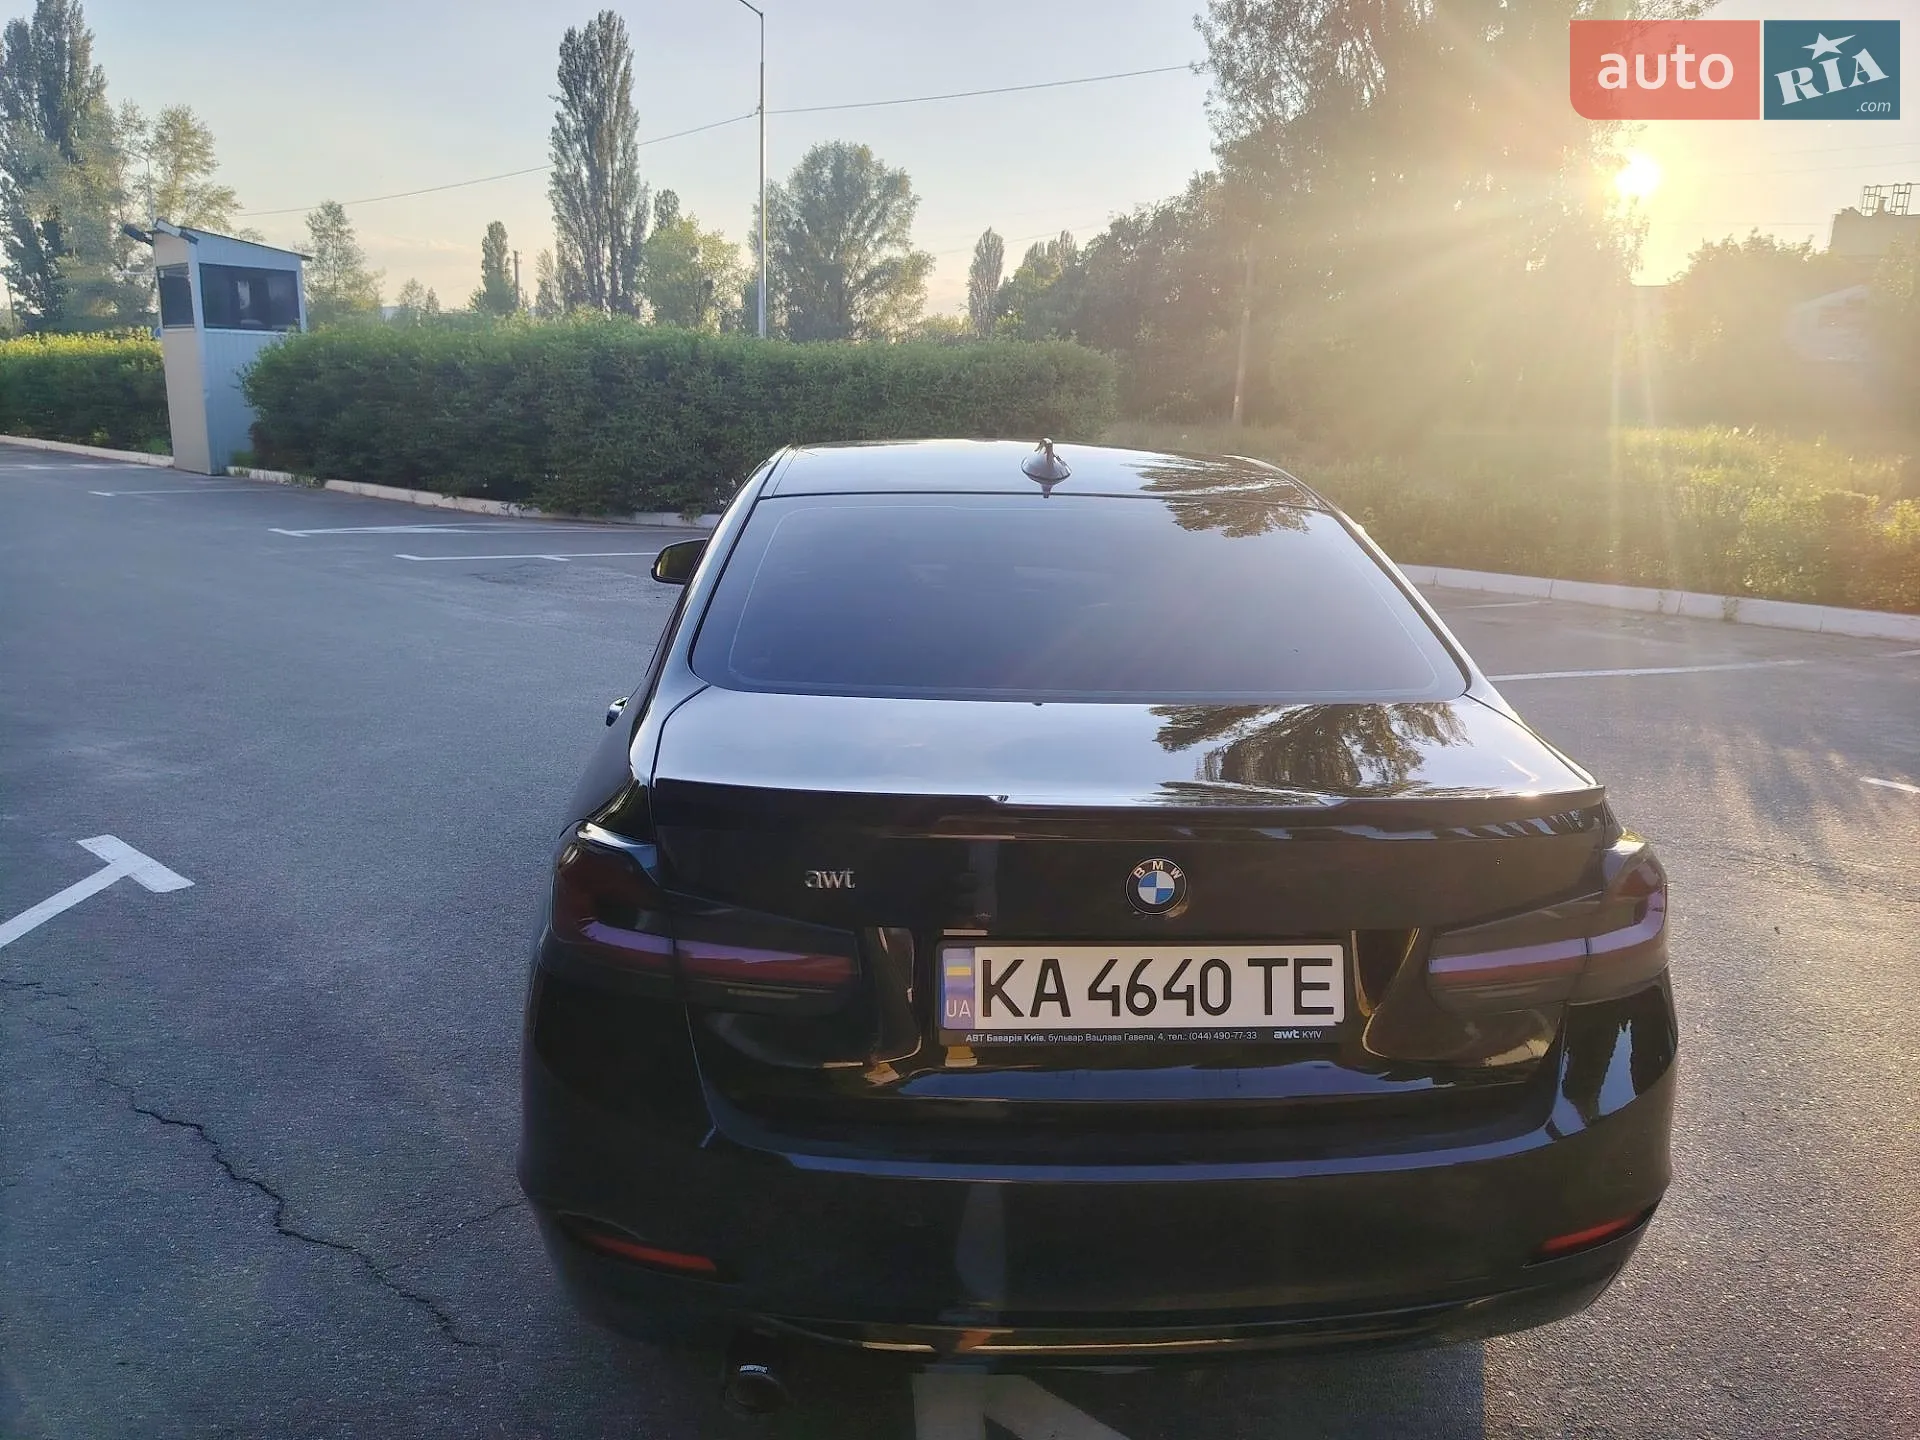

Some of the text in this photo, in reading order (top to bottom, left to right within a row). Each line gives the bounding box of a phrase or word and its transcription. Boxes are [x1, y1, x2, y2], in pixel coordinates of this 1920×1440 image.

[804, 868, 857, 889] awt
[1133, 860, 1183, 880] BMW
[982, 957, 1335, 1018] KA 4640 TE
[946, 999, 972, 1018] UA
[965, 1033, 985, 1043] АВТ
[986, 1033, 1023, 1044] Баварія
[1048, 1033, 1084, 1044] бульвар
[1085, 1032, 1122, 1043] Вацлава
[1124, 1032, 1156, 1042] Гавела,
[1189, 1031, 1212, 1041] (044)
[1213, 1031, 1257, 1040] 490-77-33
[1273, 1029, 1322, 1039] awt KYIV
